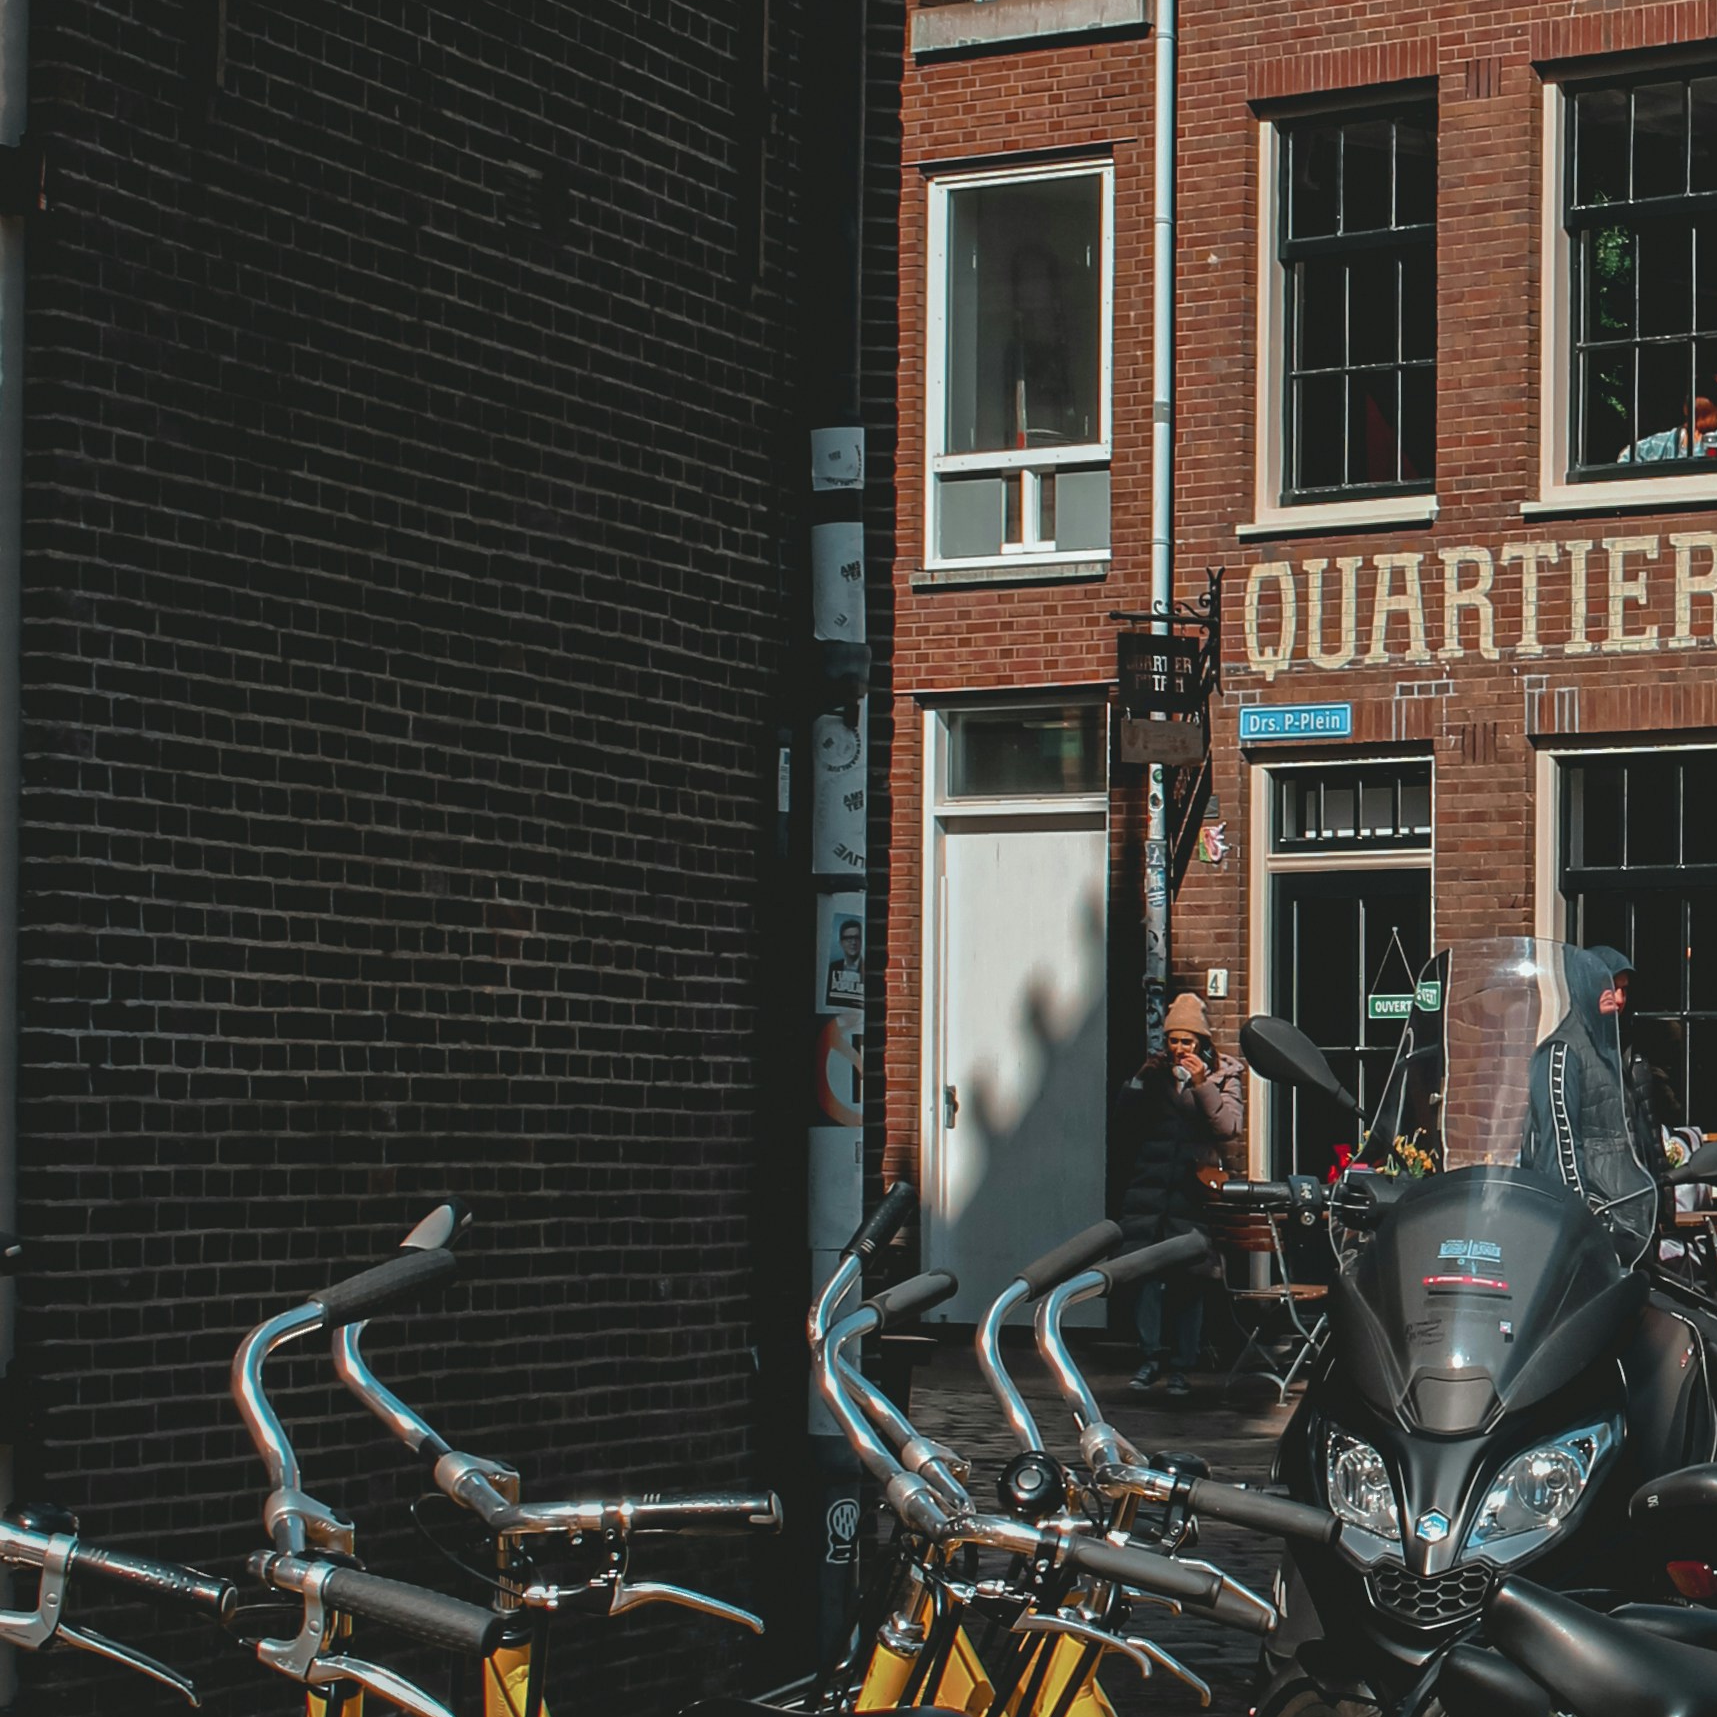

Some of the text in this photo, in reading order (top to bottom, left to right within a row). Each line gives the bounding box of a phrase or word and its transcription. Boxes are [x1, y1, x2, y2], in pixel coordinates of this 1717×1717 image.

[1249, 710, 1340, 732] Drs. P-Plein
[1208, 973, 1220, 994] 4
[1375, 1000, 1414, 1013] OUVERT
